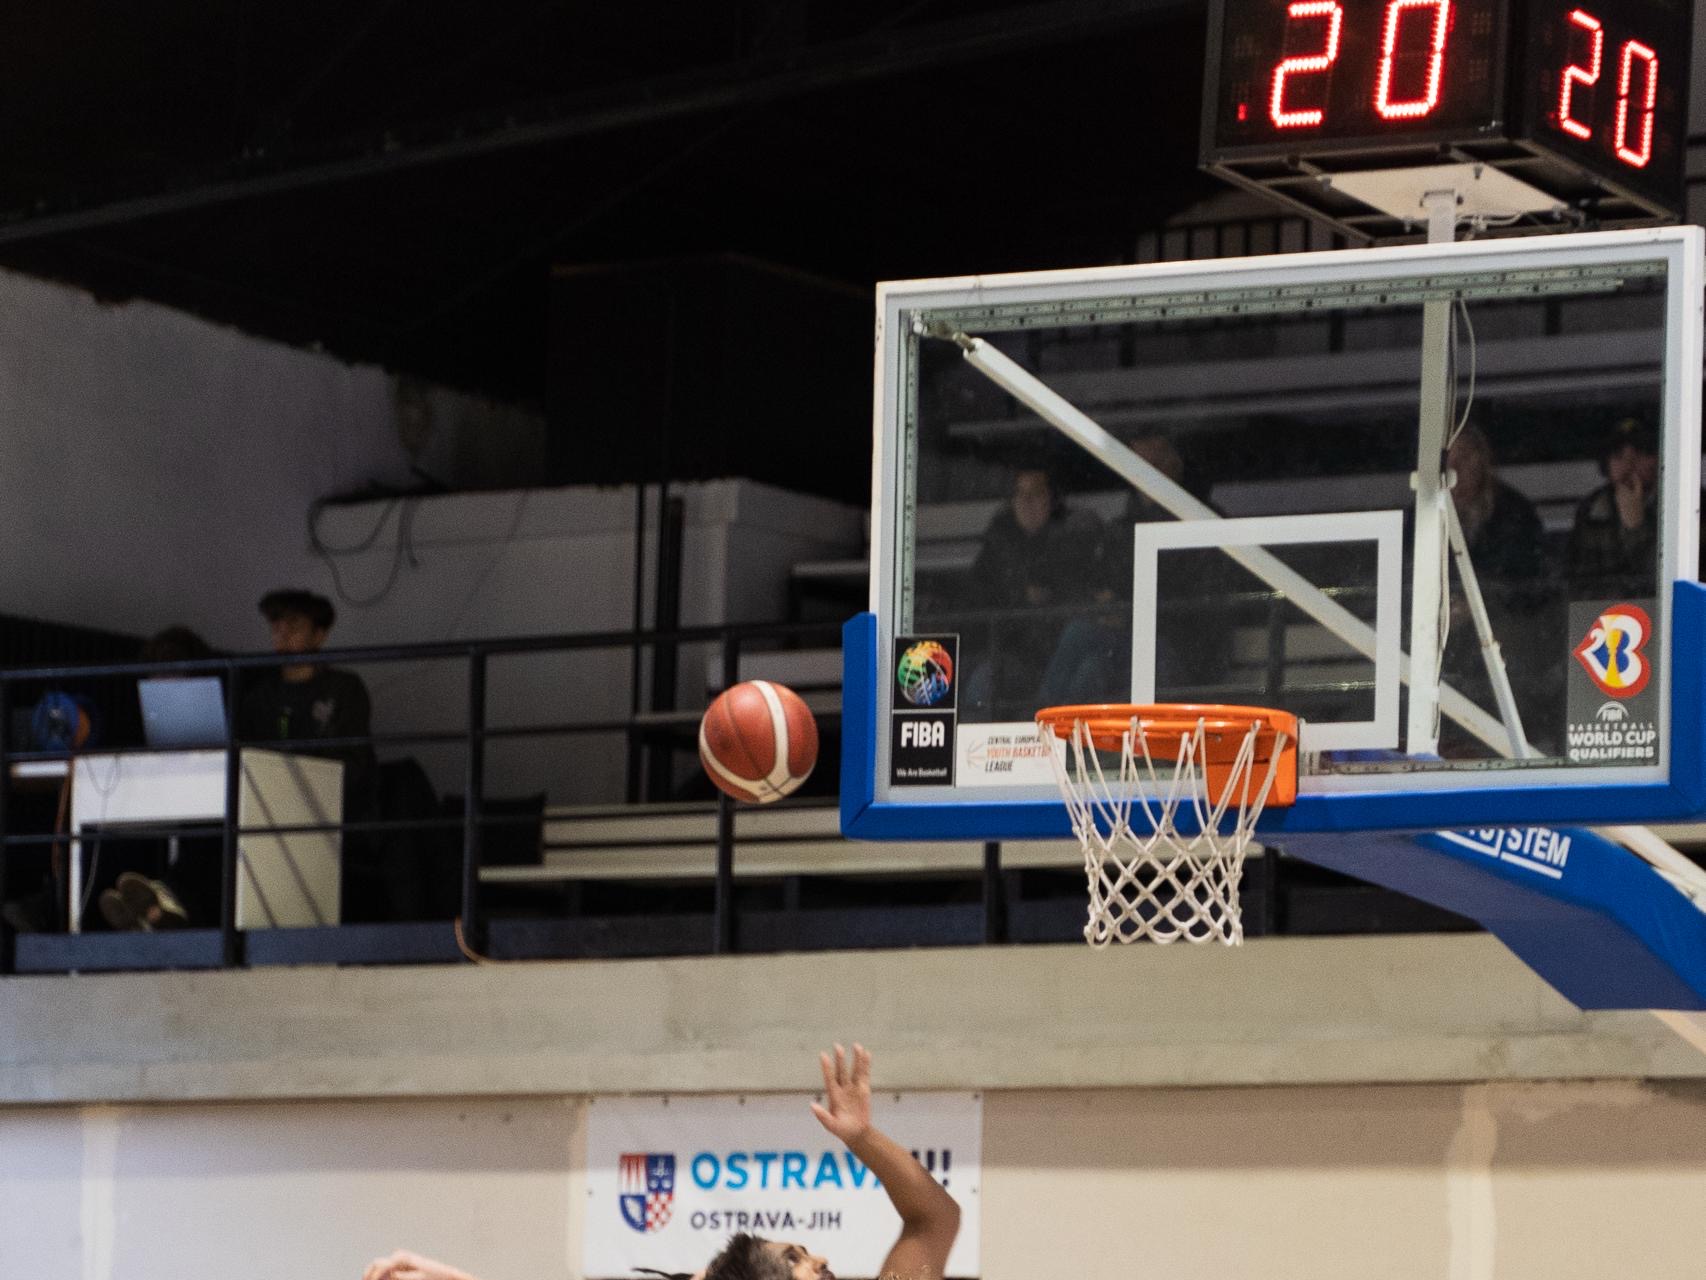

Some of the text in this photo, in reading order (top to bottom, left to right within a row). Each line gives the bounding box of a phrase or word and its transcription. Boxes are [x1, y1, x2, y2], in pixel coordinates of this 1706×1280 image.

[1270, 0, 1451, 127] 20
[1560, 9, 1658, 168] 20
[901, 720, 945, 748] FIBA
[1568, 722, 1653, 731] BASKETBALL
[1568, 730, 1656, 746] WORLD CUP
[1569, 746, 1654, 762] QUALIFIERS
[985, 760, 1014, 772] LEAGUE
[690, 1211, 843, 1231] OSTRAVA-JIH
